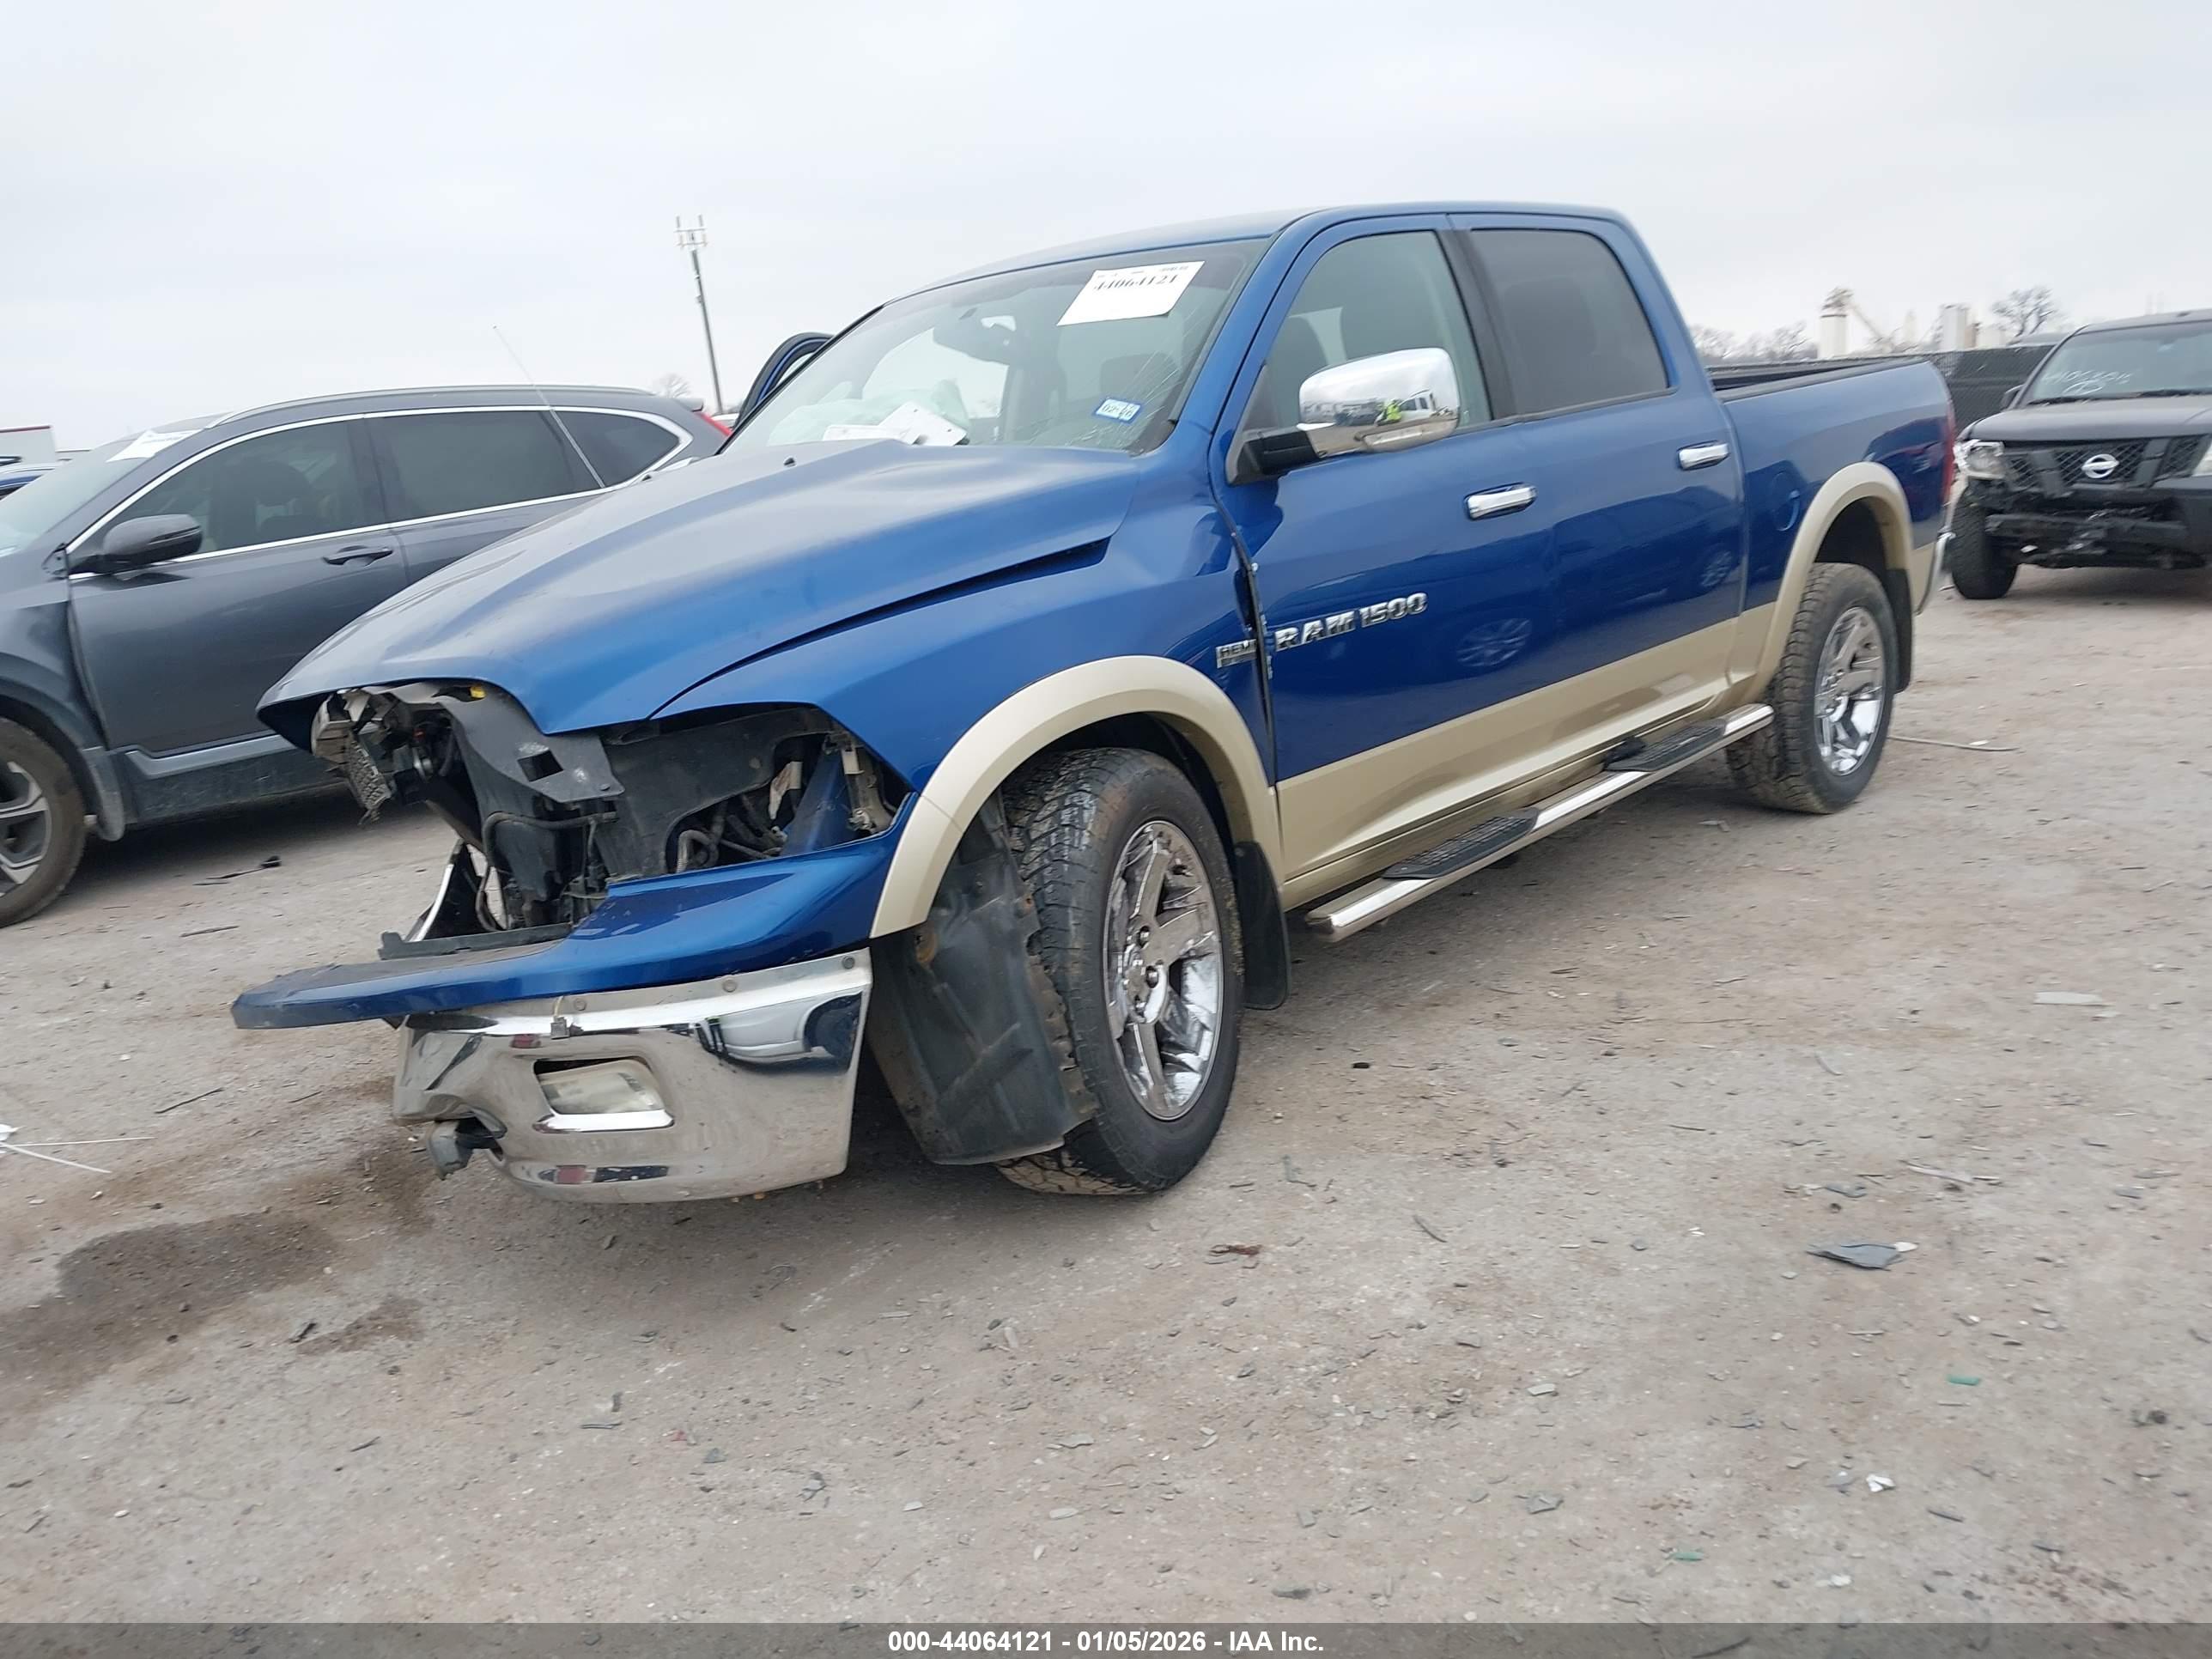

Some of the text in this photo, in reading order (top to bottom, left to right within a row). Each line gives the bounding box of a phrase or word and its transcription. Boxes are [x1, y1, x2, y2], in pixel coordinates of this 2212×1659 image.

[1093, 274, 1178, 291] 44064121
[1275, 592, 1428, 653] RAM 1500
